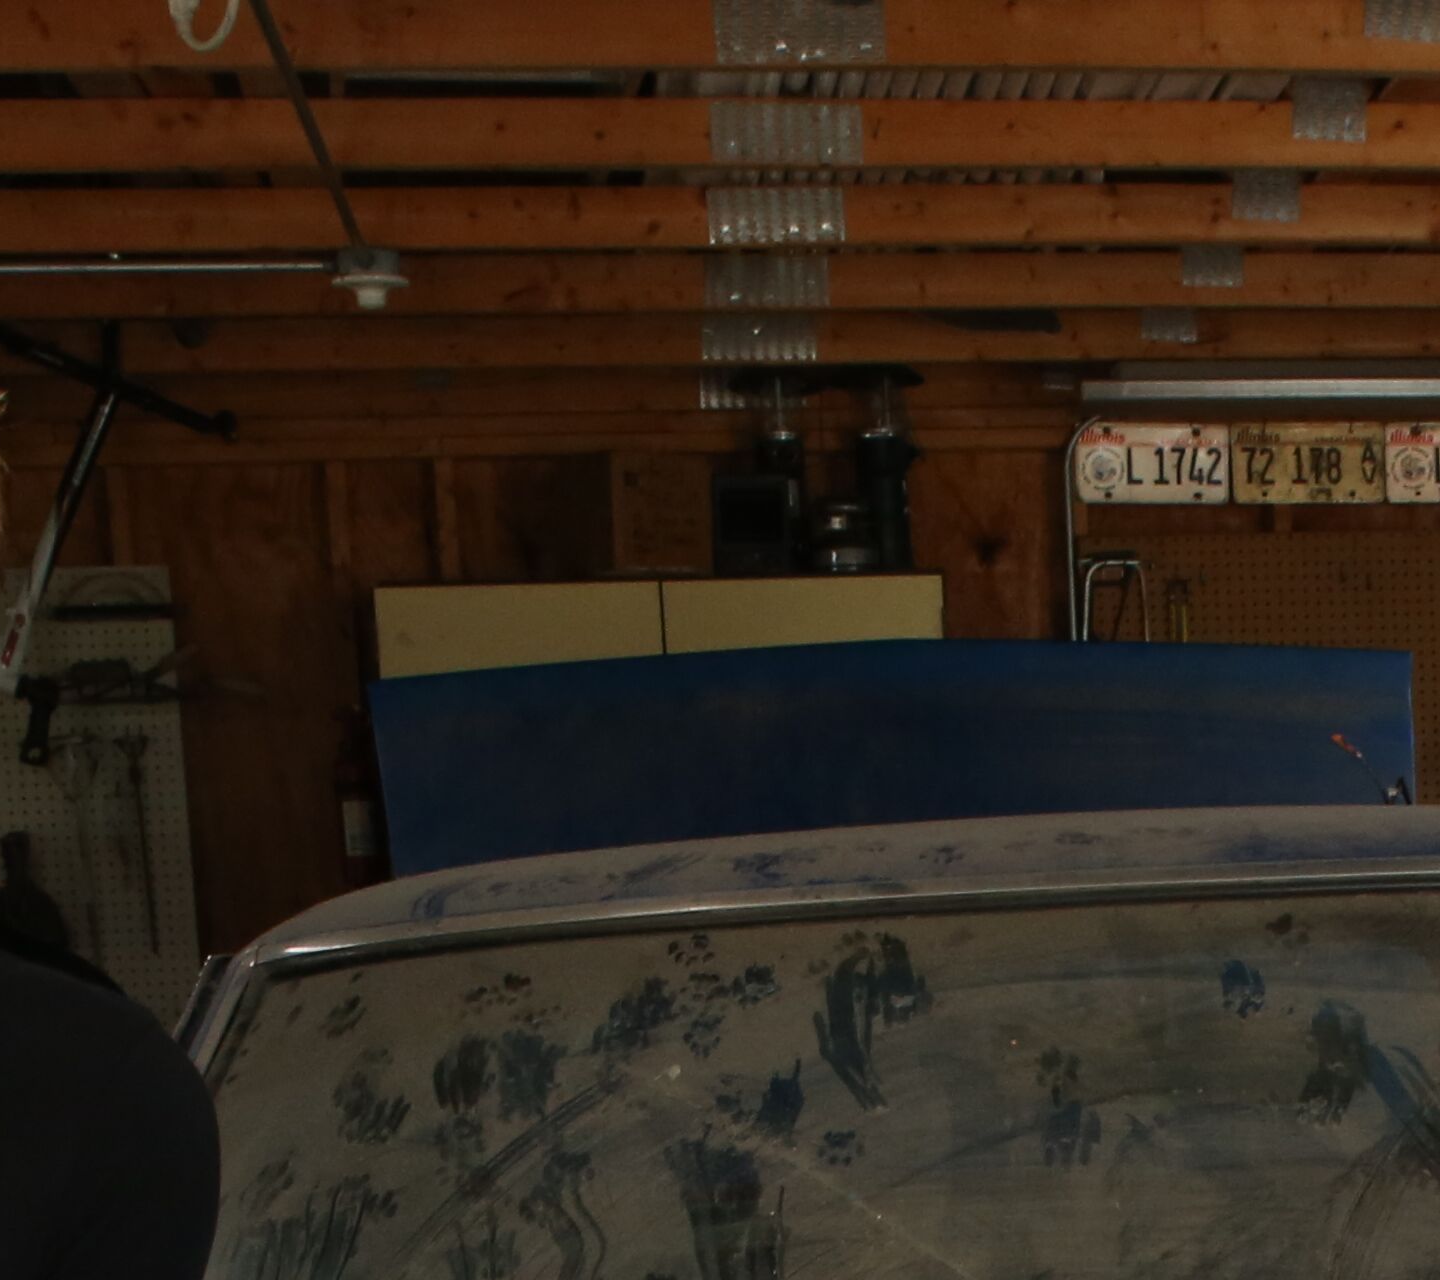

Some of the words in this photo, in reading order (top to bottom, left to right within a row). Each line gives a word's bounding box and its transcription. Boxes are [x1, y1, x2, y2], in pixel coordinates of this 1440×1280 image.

[1126, 447, 1144, 485] L
[1153, 447, 1223, 485] 1742
[1241, 447, 1276, 485] 72
